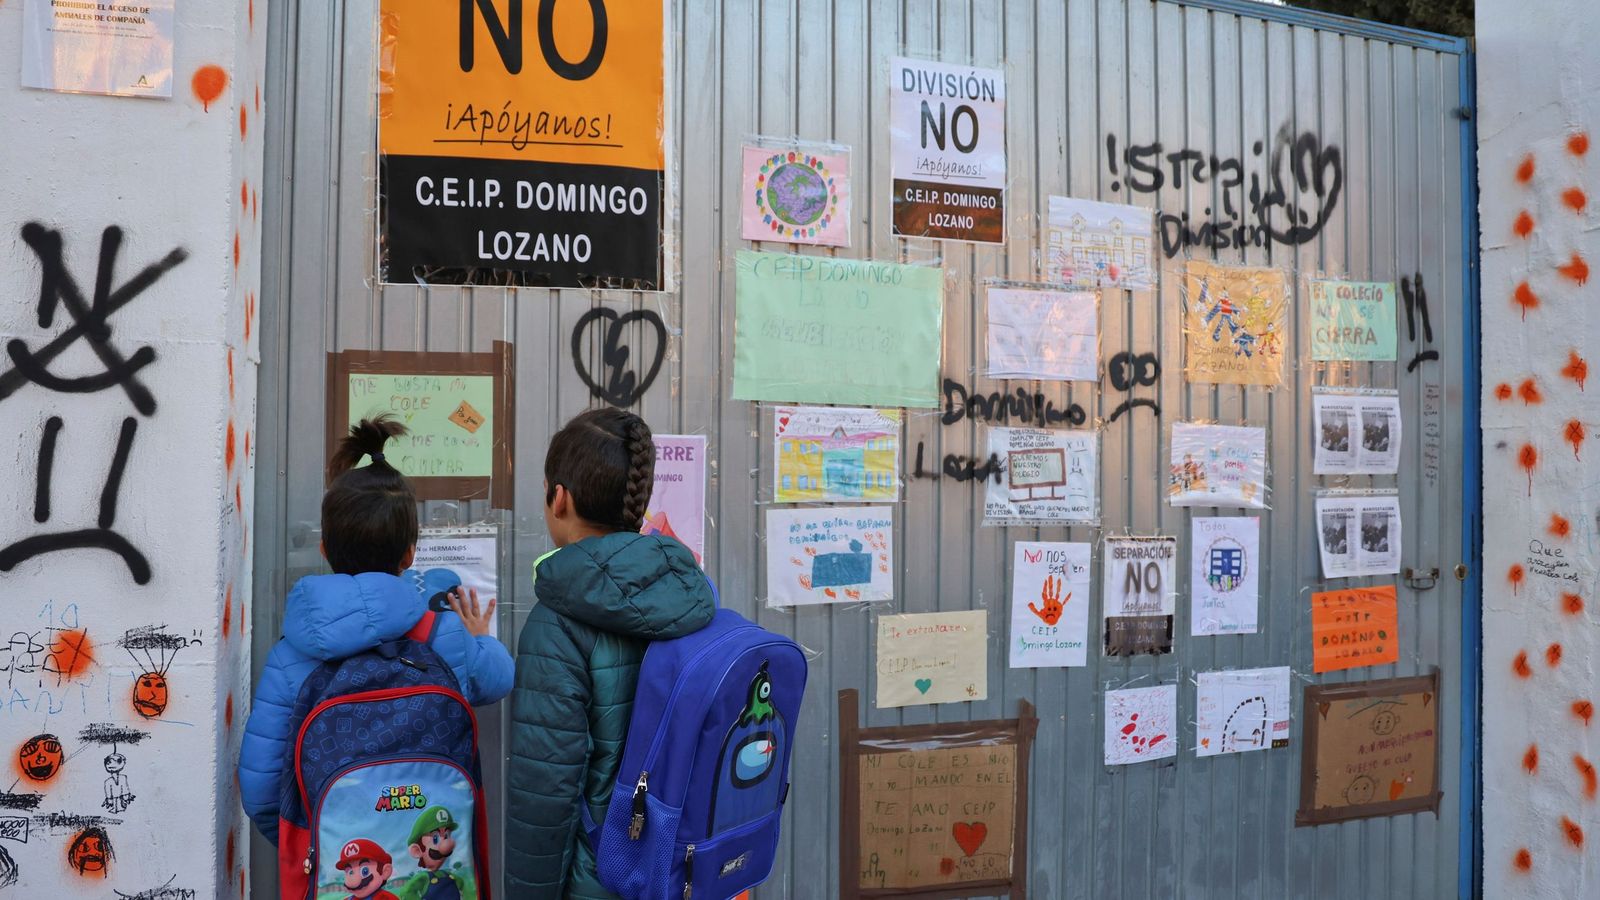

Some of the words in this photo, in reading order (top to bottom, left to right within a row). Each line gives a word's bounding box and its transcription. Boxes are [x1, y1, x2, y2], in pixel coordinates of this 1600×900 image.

[51, 1, 96, 10] PROHIBIDO
[107, 4, 138, 13] ACCESO
[54, 11, 93, 20] ANIMALES
[94, 14, 104, 22] DE
[458, 0, 608, 81] NO
[902, 68, 996, 103] DIVISIÓN
[446, 101, 612, 151] ¡Apóyanos!
[920, 99, 979, 154] NO
[415, 176, 504, 208] C.E.I.P.
[516, 180, 648, 216] DOMINGO
[905, 187, 940, 205] C.E.I.P.
[943, 191, 997, 210] DOMINGO
[928, 211, 974, 230] LOZANO
[478, 230, 592, 263] LOZANO
[817, 260, 903, 286] DOMINGO
[1113, 545, 1173, 560] SEPARACIÓN
[1529, 539, 1565, 556] Que
[1125, 561, 1162, 594] NO
[1031, 626, 1059, 636] CEIP
[952, 755, 969, 768] ES
[976, 773, 992, 783] EN
[381, 784, 422, 797] SUPER
[375, 794, 427, 812] MARIO
[874, 800, 898, 816] TE
[912, 802, 949, 817] AMO
